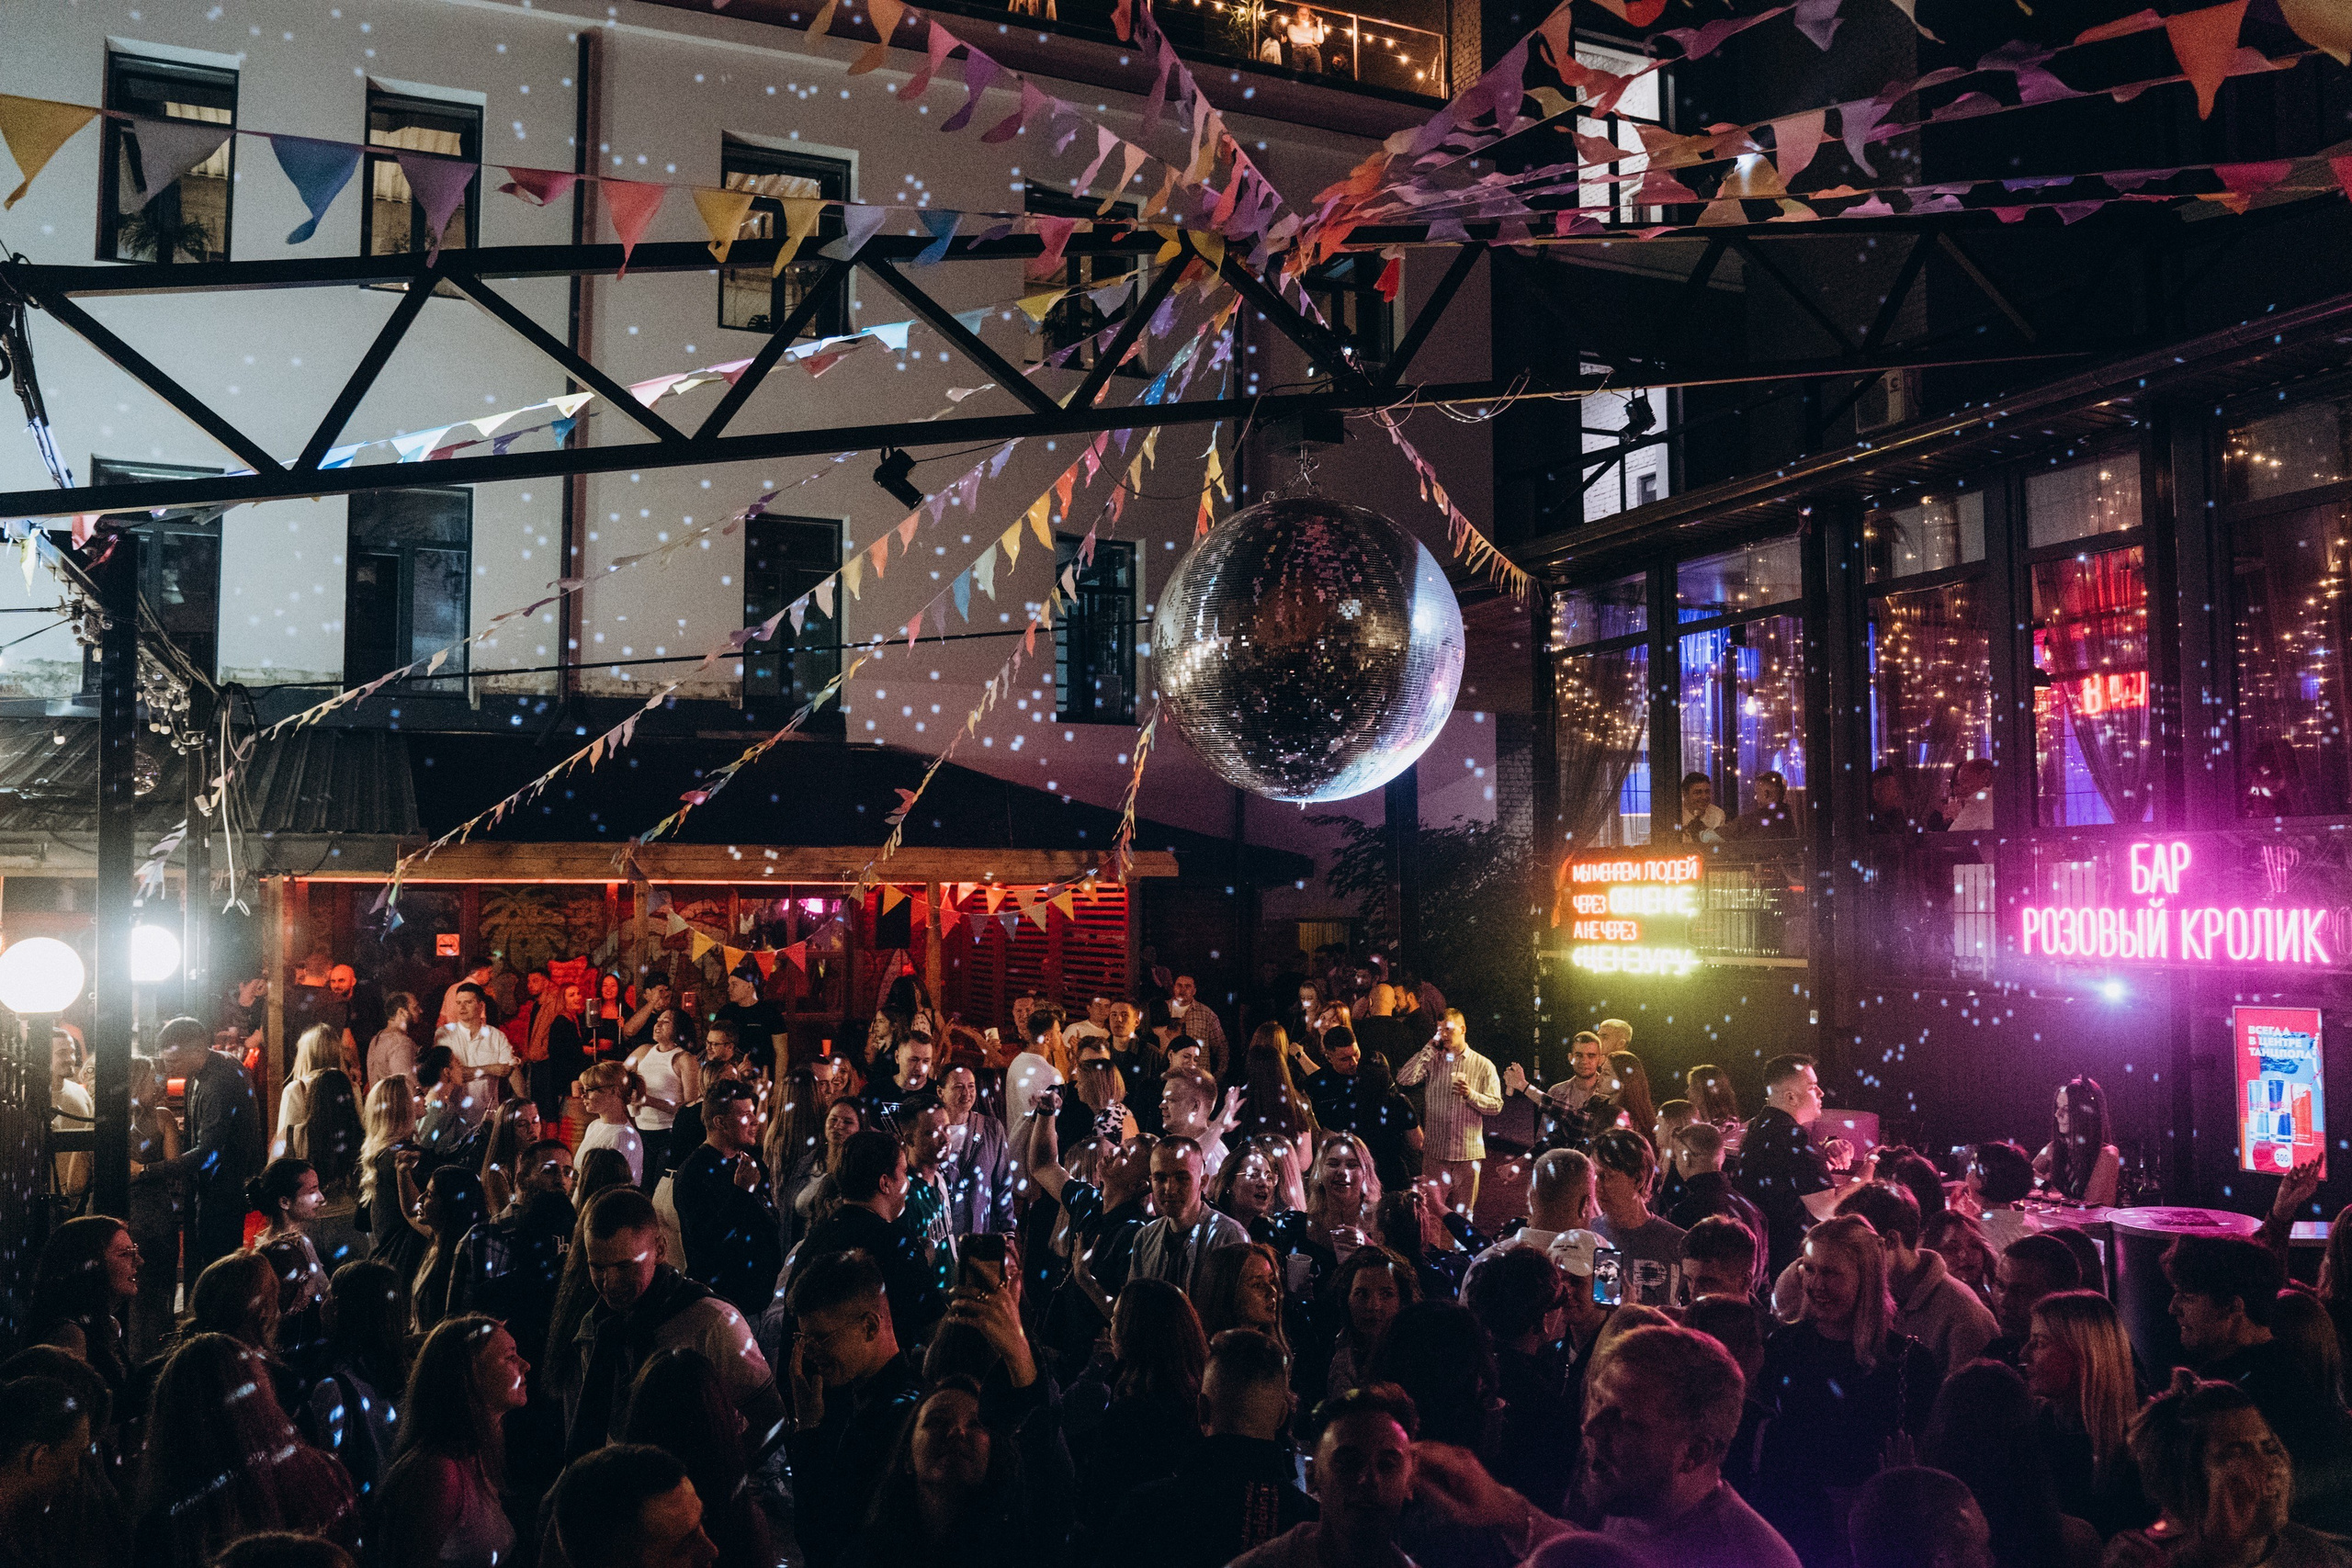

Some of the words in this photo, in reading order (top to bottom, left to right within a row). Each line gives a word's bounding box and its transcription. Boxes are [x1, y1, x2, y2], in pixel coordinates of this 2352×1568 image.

[1572, 863, 1591, 883] МЫ
[1592, 862, 1641, 882] МЕНЯЕМ
[1643, 855, 1698, 885] ЛЮДЕЙ
[2130, 841, 2191, 895] БАР
[1572, 895, 1607, 914] ЧЕРЕЗ
[1573, 921, 1584, 939] А
[1584, 920, 1600, 940] НЕ
[1600, 919, 1637, 941] ЧЕРЕЗ
[2021, 897, 2169, 960] РОЗОВЫЙ
[2180, 907, 2331, 964] КРОЛИК
[2247, 1025, 2290, 1036] ВСЕГДА
[2248, 1036, 2256, 1045] В
[2258, 1037, 2302, 1048] ЦЕНТРЕ
